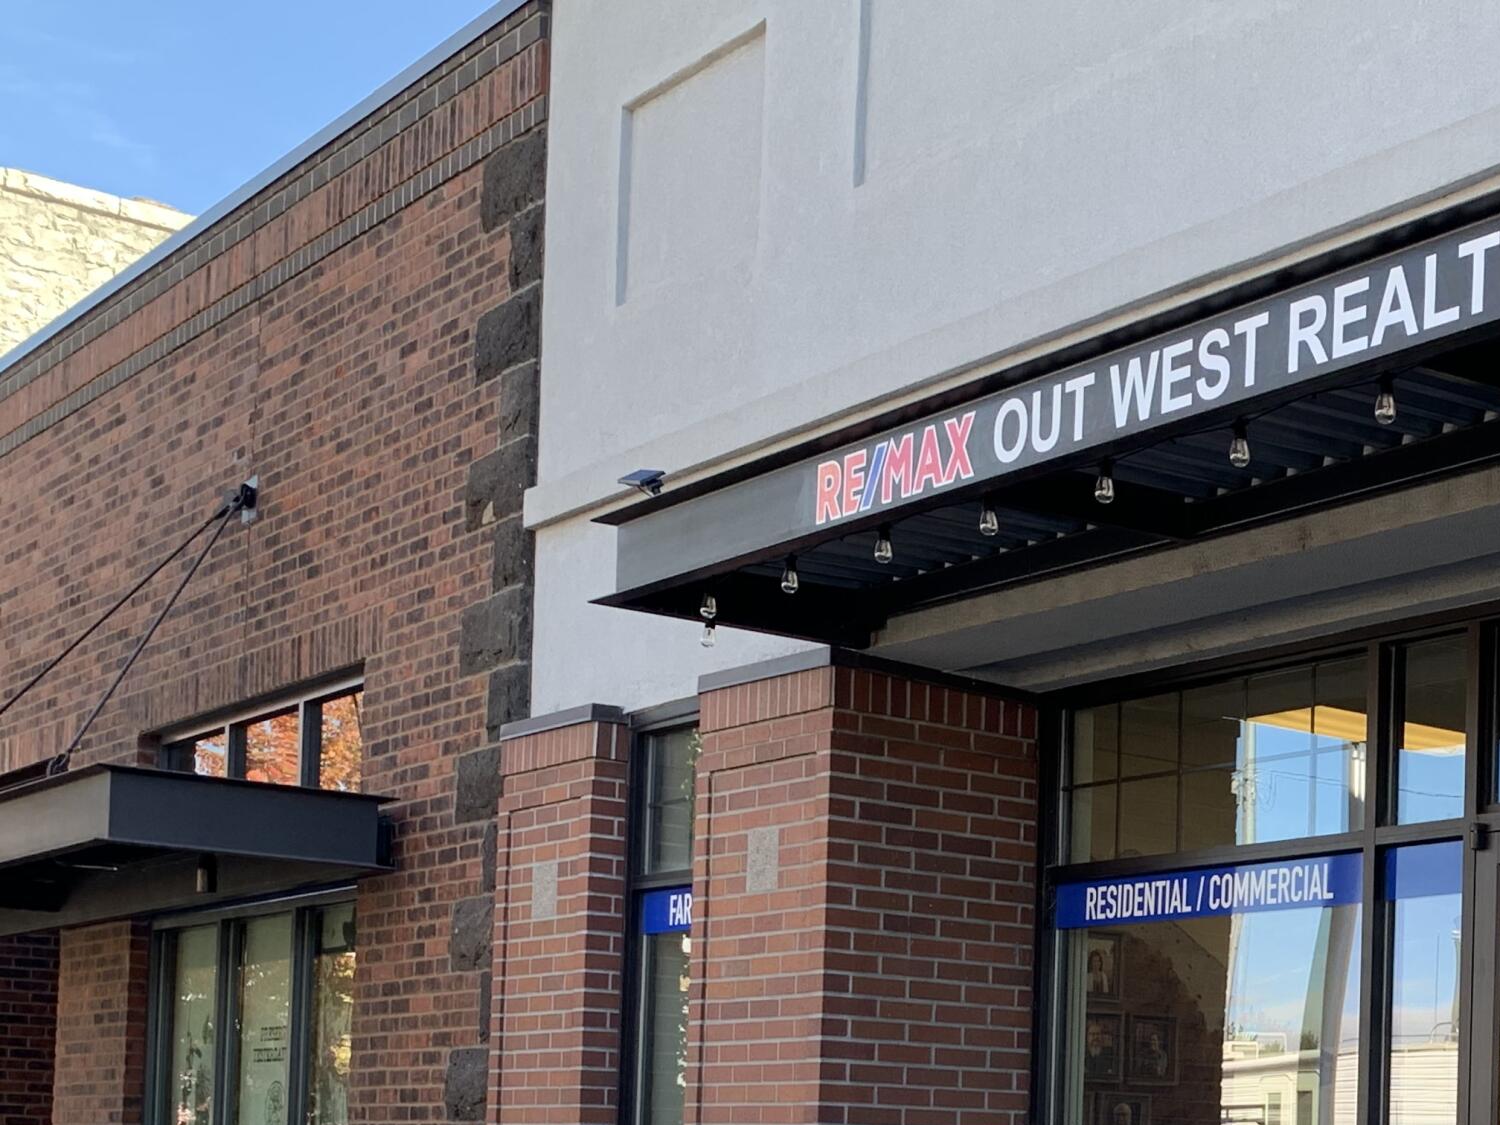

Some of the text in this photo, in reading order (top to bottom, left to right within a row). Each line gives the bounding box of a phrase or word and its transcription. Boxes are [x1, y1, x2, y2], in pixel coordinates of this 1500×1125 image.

[815, 410, 976, 525] RE/MAX
[993, 372, 1096, 463] OUT
[1109, 310, 1270, 428] WEST
[1085, 879, 1192, 921] RESIDENTIAL
[1208, 863, 1334, 910] COMMERCIAL
